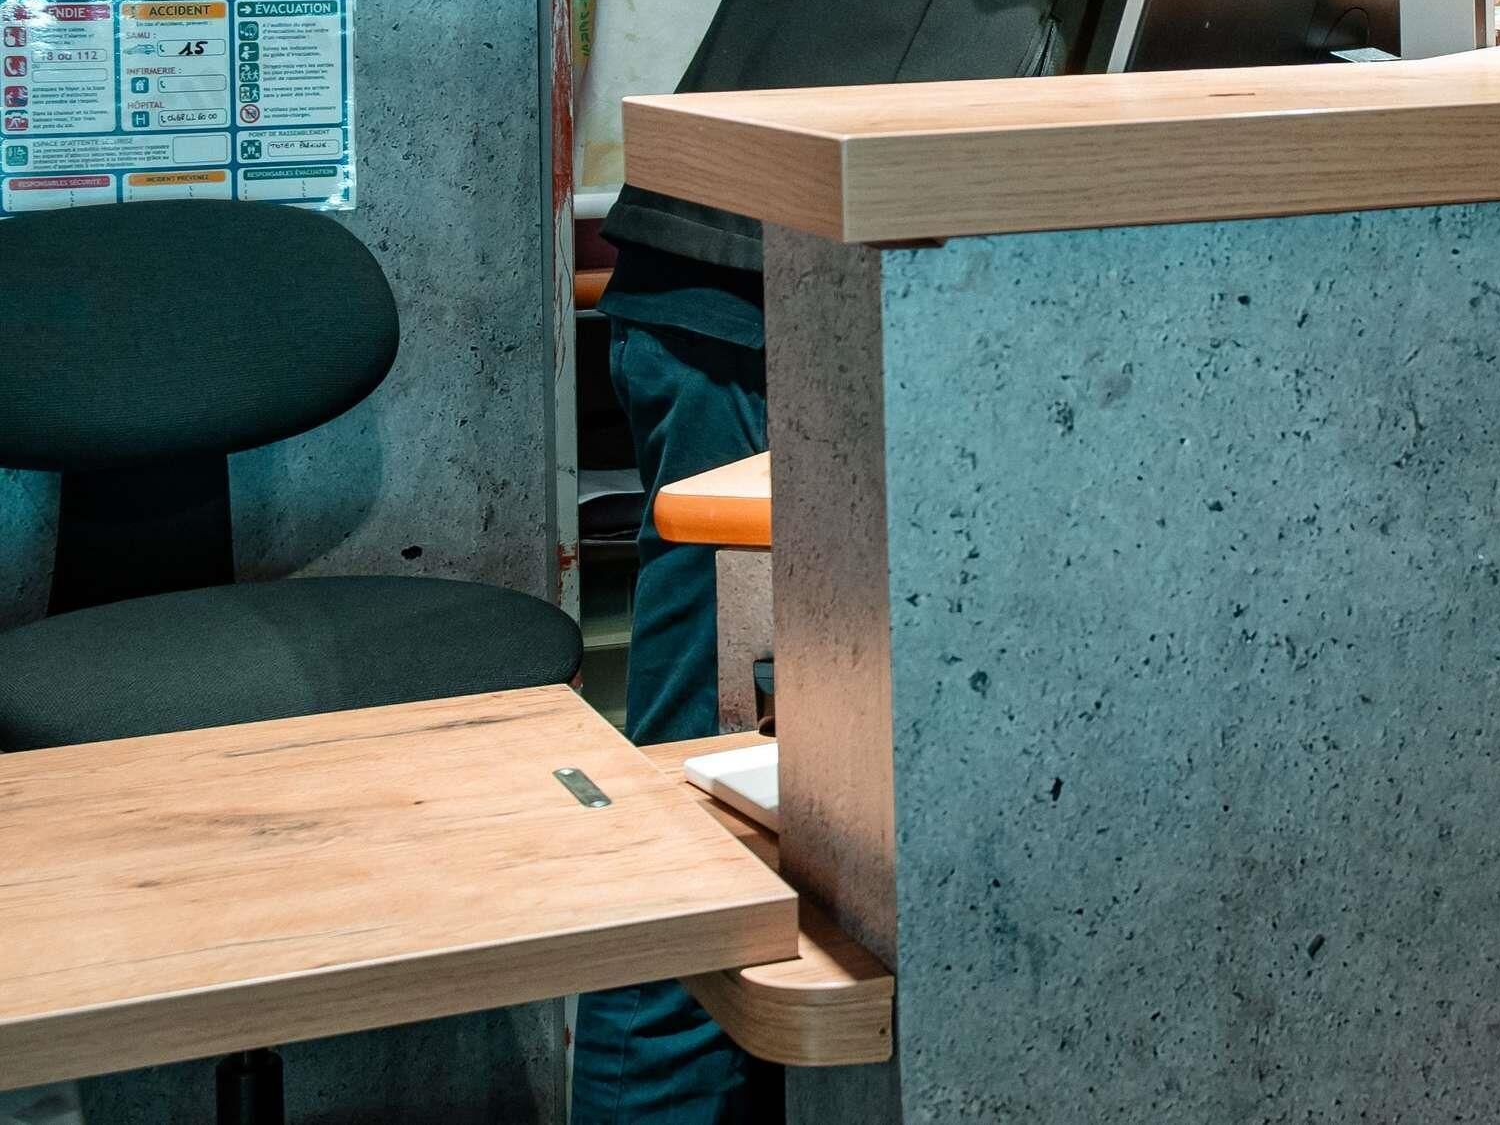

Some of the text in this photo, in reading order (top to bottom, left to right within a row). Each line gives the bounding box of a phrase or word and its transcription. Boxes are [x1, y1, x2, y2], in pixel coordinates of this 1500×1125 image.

[149, 5, 211, 16] ACCIDENT
[255, 1, 331, 14] ÉVACUATION
[178, 41, 208, 55] 15
[78, 51, 98, 60] 112
[126, 67, 175, 75] INFIRMERIE
